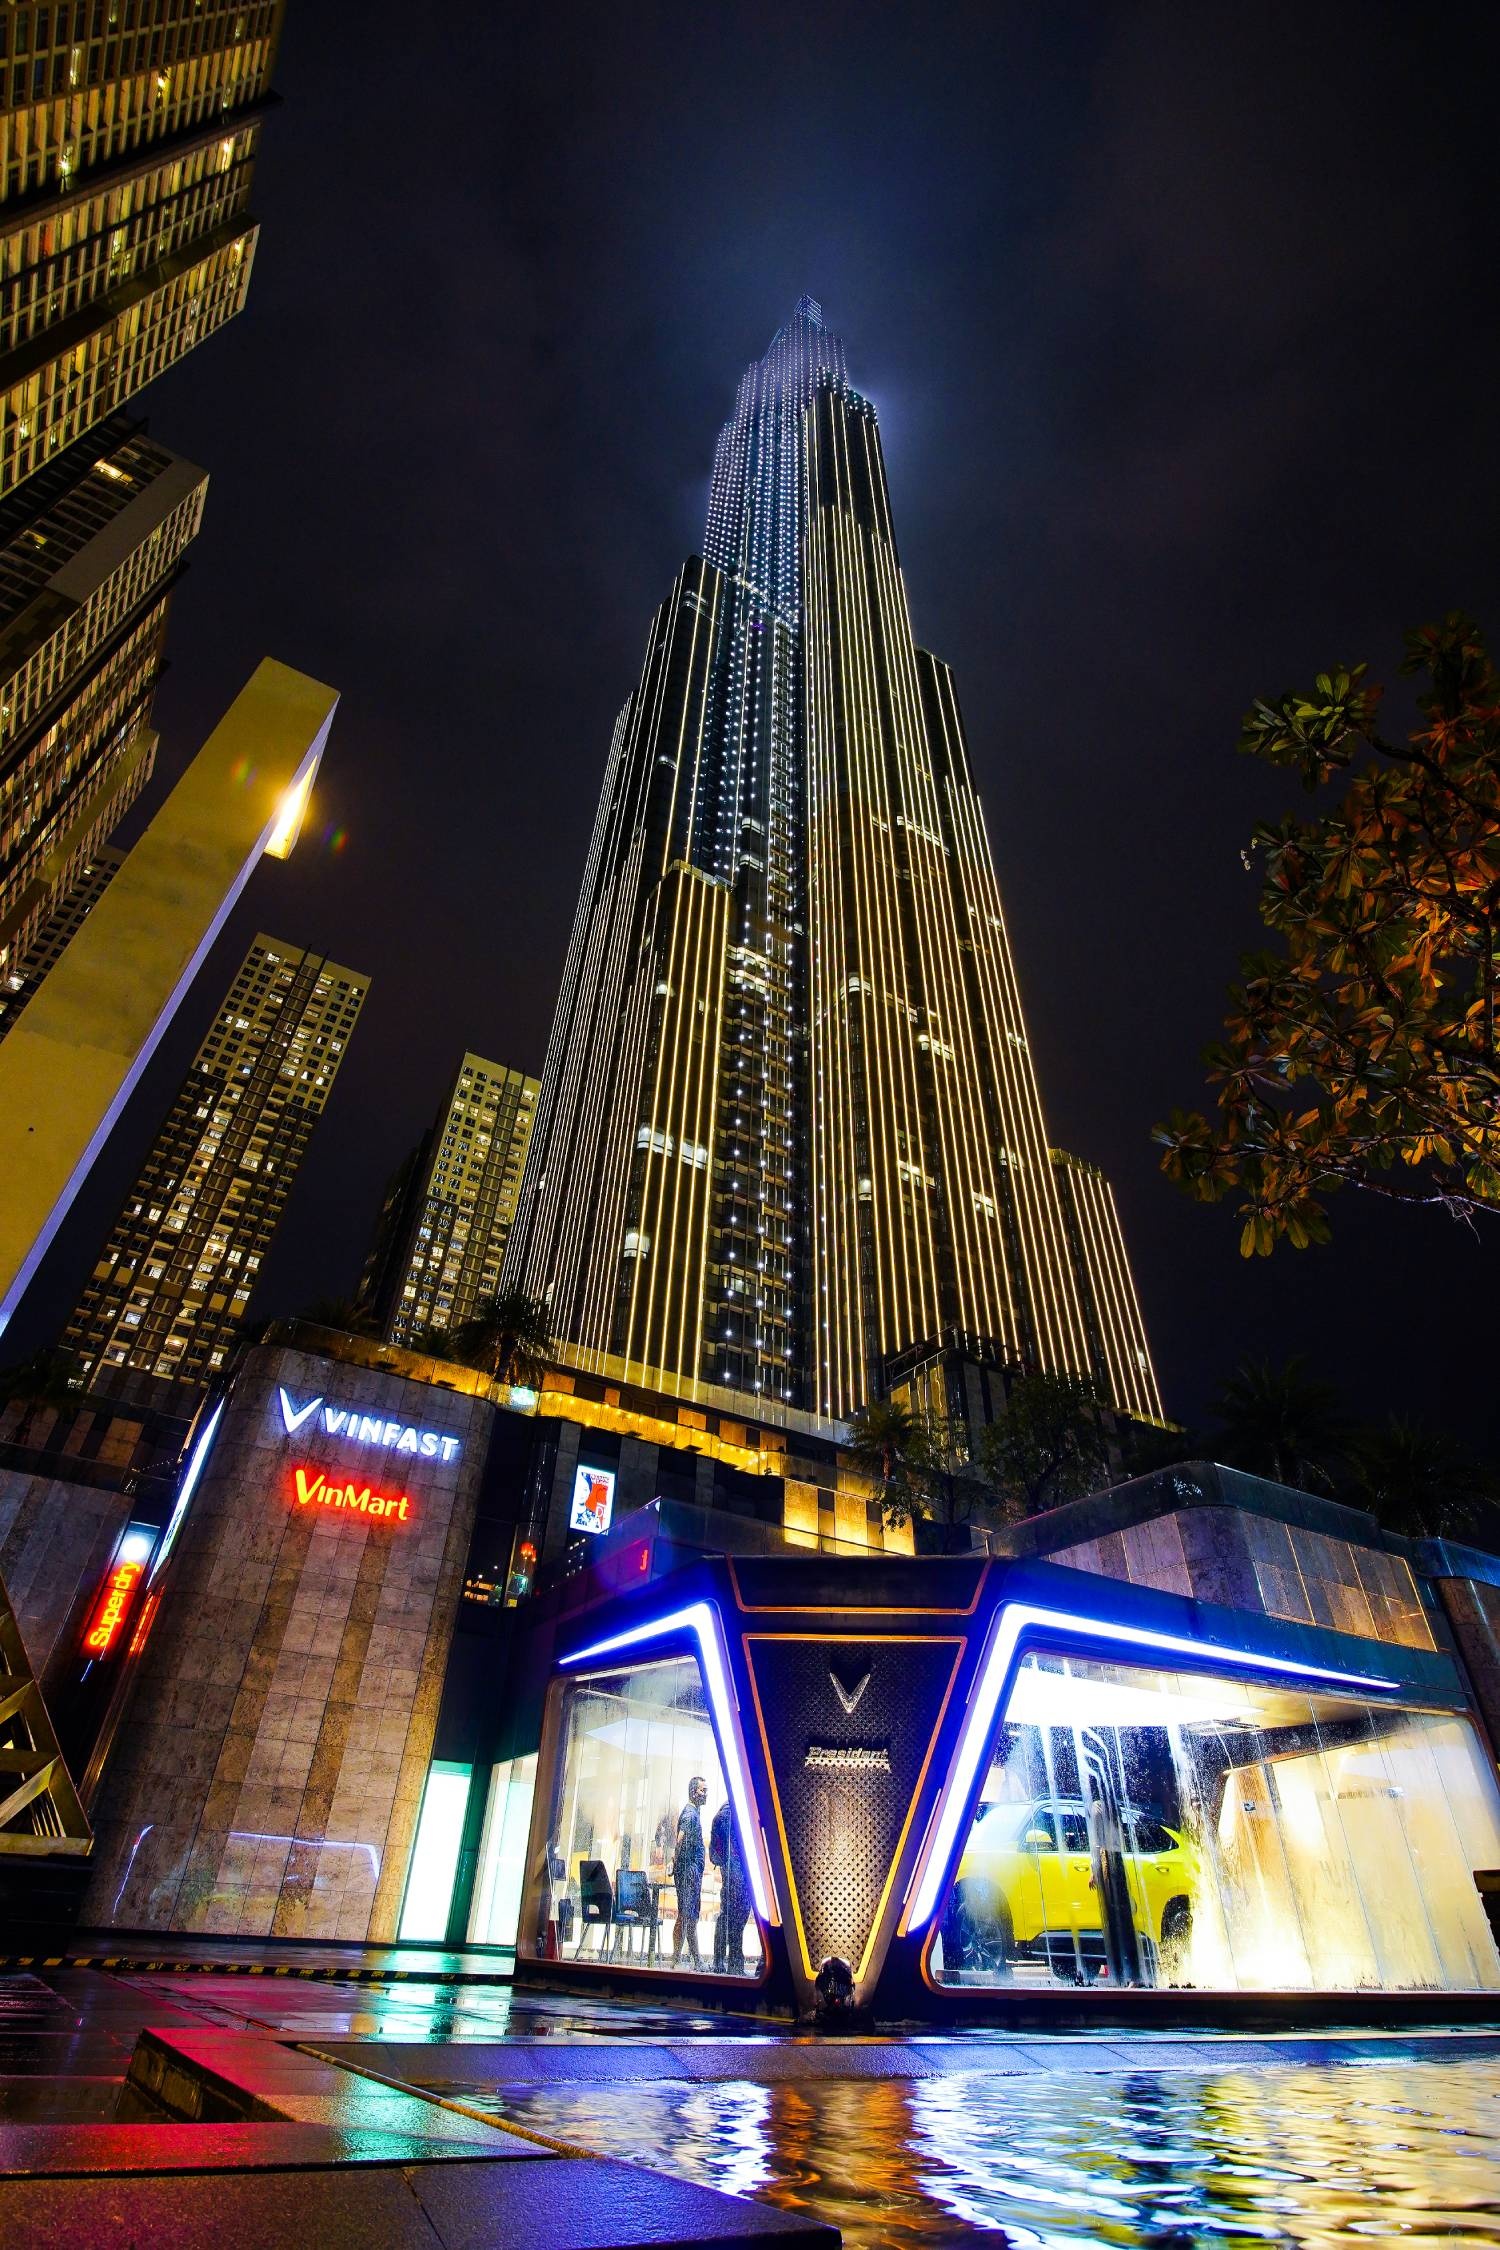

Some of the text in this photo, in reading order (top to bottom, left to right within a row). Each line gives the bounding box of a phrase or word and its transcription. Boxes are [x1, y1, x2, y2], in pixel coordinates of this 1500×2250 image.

[324, 1407, 460, 1461] VINFAST
[295, 1469, 410, 1521] VinMart
[89, 1561, 141, 1647] Superdry
